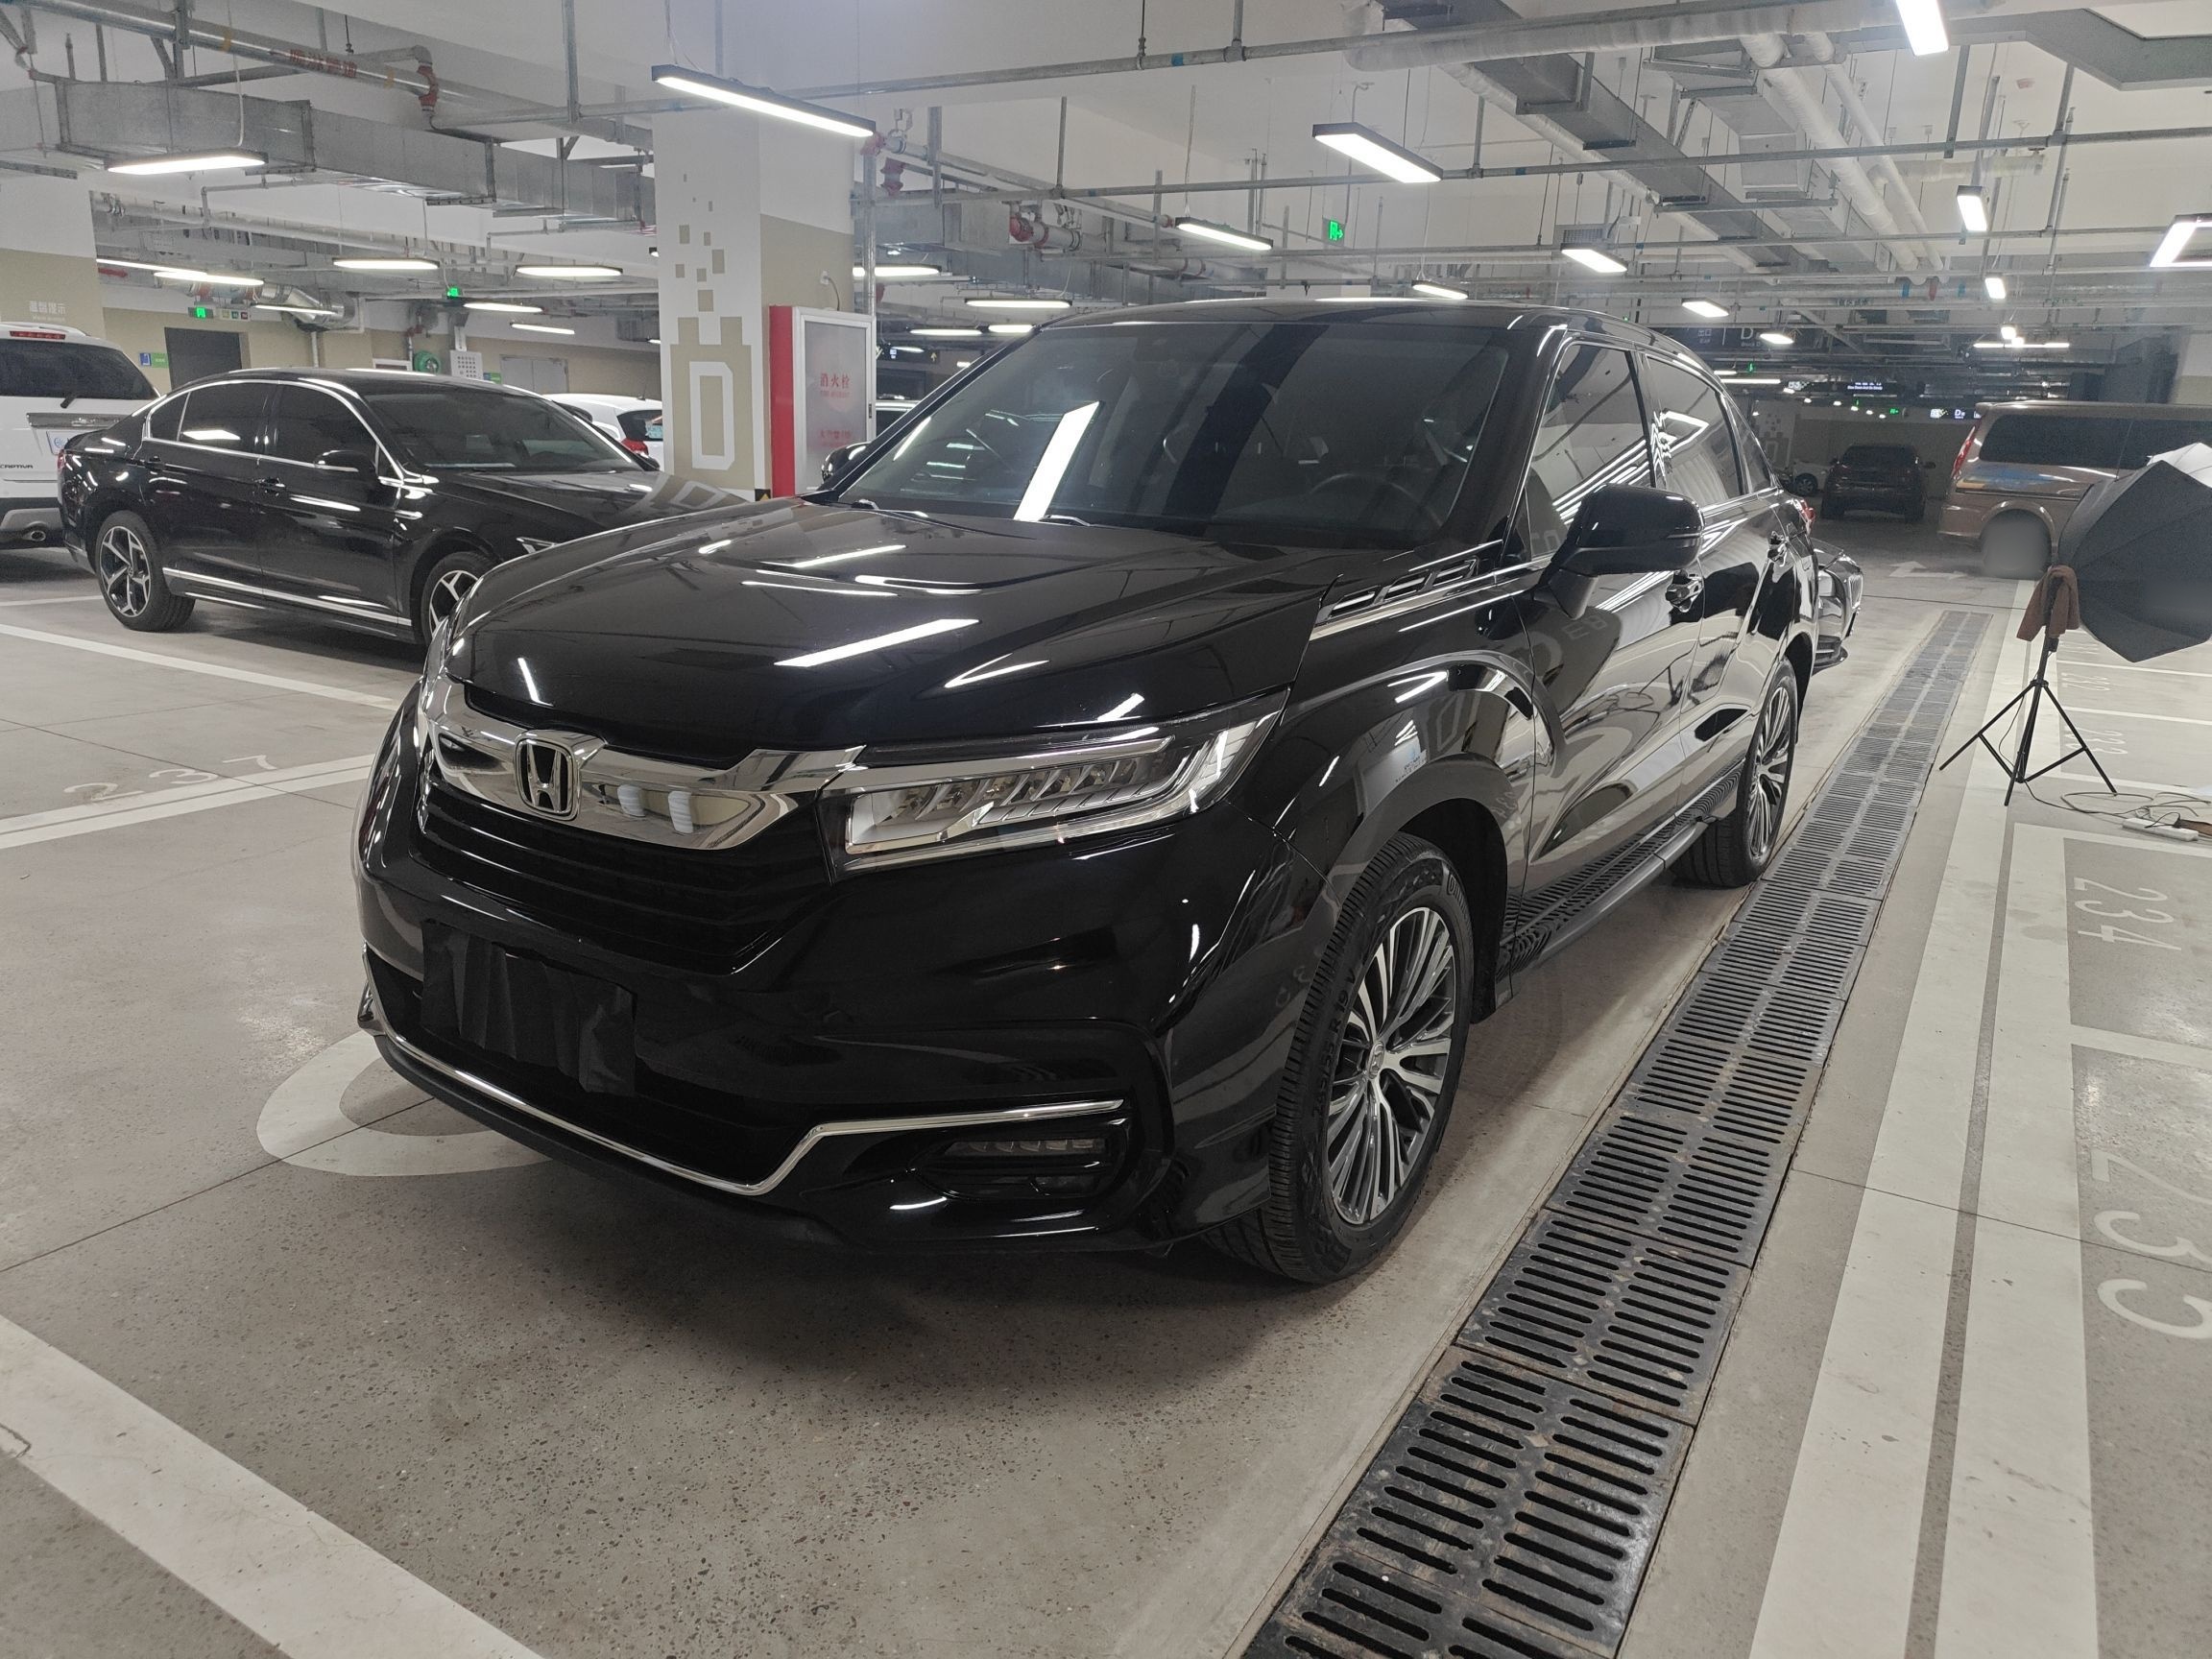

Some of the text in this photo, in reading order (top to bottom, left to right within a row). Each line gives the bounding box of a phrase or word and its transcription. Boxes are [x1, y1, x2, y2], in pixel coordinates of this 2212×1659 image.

[820, 373, 851, 389] 消火栓
[688, 361, 735, 470] D
[63, 755, 277, 802] 237
[2074, 878, 2181, 950] 234
